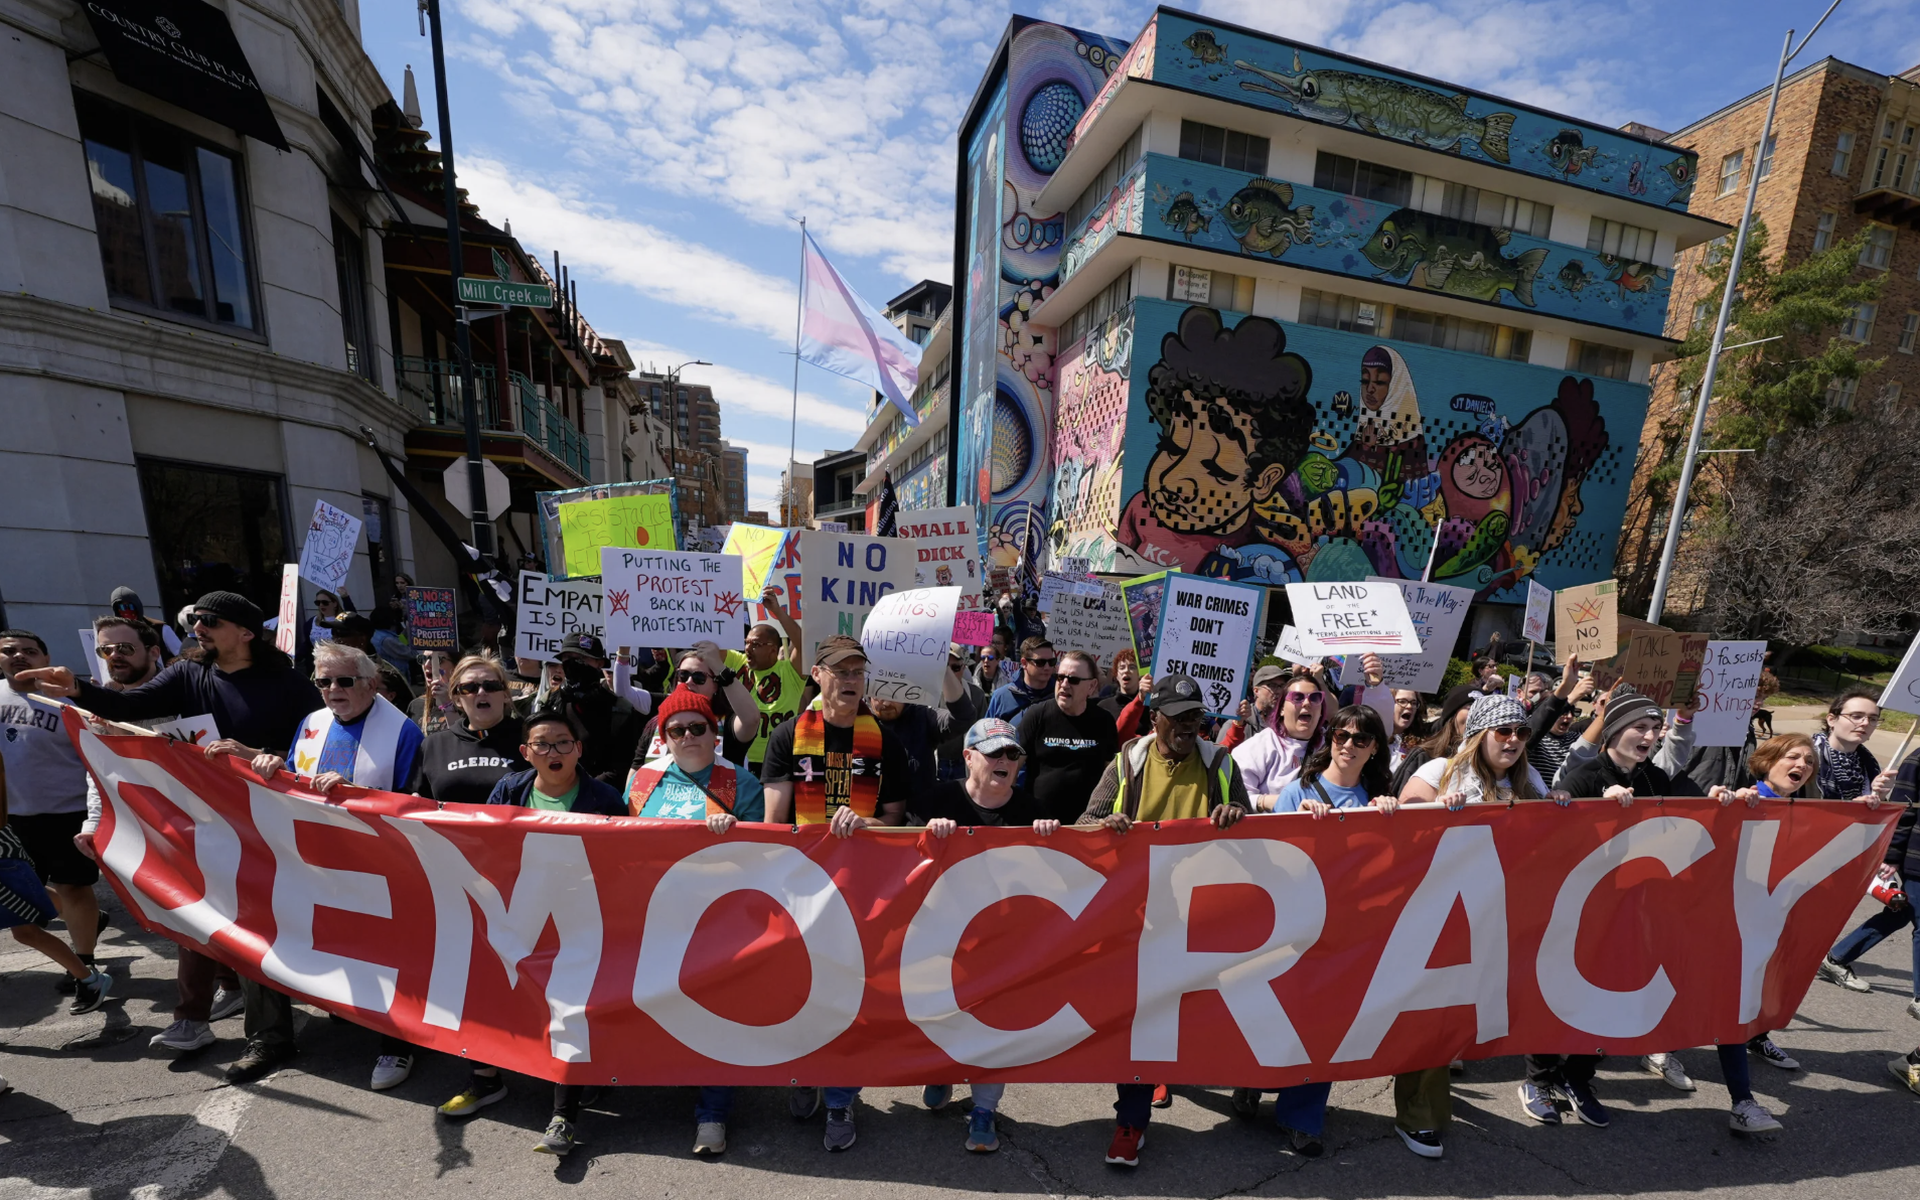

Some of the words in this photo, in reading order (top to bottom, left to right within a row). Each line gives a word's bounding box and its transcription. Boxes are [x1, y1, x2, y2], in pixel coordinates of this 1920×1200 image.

[87, 2, 167, 47] COUNTRY
[171, 41, 211, 67] CLUB
[213, 60, 259, 91] PLAZA
[463, 282, 486, 299] Mill
[493, 285, 532, 303] Creek
[534, 294, 551, 304] PKWY
[1453, 397, 1465, 409] JT
[1465, 398, 1495, 415] DANIELS
[564, 499, 671, 530] Resistance
[899, 521, 970, 539] SMALL
[622, 553, 691, 572] PUTTING
[699, 558, 721, 573] THE
[838, 541, 887, 572] NO
[917, 546, 966, 562] DICK
[1143, 543, 1170, 567] KC
[637, 574, 714, 597] PROTEST
[1313, 585, 1368, 600] LAND
[423, 591, 438, 601] NO
[650, 597, 685, 612] BACK
[690, 601, 705, 613] IN
[896, 589, 931, 603] NO
[1055, 592, 1069, 604] If
[1070, 597, 1082, 607] the
[1083, 597, 1107, 612] USA
[1176, 591, 1203, 609] WAR
[1205, 595, 1250, 617] CRIMES
[1416, 587, 1436, 606] The
[1435, 590, 1465, 615] Way:
[529, 610, 556, 626] IS
[872, 602, 940, 618] KINGS
[1055, 608, 1067, 616] the
[1071, 609, 1084, 617] USA
[1097, 612, 1112, 622] doing
[412, 615, 453, 627] AMERICA
[631, 615, 725, 635] PROTESTANT
[1072, 619, 1083, 627] the
[1085, 621, 1099, 630] USA
[1102, 624, 1118, 632] would
[1190, 616, 1225, 635] DON'T
[413, 637, 455, 647] DEMOCRACY
[417, 628, 450, 639] PROTECT
[1053, 626, 1064, 636] the
[1067, 628, 1082, 637] USA
[1094, 631, 1116, 641] liberate
[1576, 626, 1599, 641] NO
[862, 629, 947, 661] AMERICA
[1051, 638, 1067, 647] USA
[1070, 639, 1084, 649] from
[1091, 642, 1101, 650] the
[1191, 639, 1218, 658] HIDE
[1567, 639, 1602, 654] KINGS
[1634, 634, 1672, 658] TAKE
[1105, 651, 1114, 659] of
[1717, 646, 1764, 666] fascists
[877, 669, 907, 680] SINCE
[1166, 658, 1189, 676] SEX
[1191, 663, 1235, 683] CRIMES
[1637, 663, 1648, 679] to
[1653, 665, 1668, 679] the
[865, 677, 922, 701] 1776
[1717, 668, 1758, 692] tyrants
[1713, 691, 1754, 720] Kings
[1044, 737, 1070, 745] LIVING
[1072, 738, 1097, 746] WATER
[447, 757, 515, 771] CLERGY
[80, 729, 1889, 1067] DEMOCRACY
